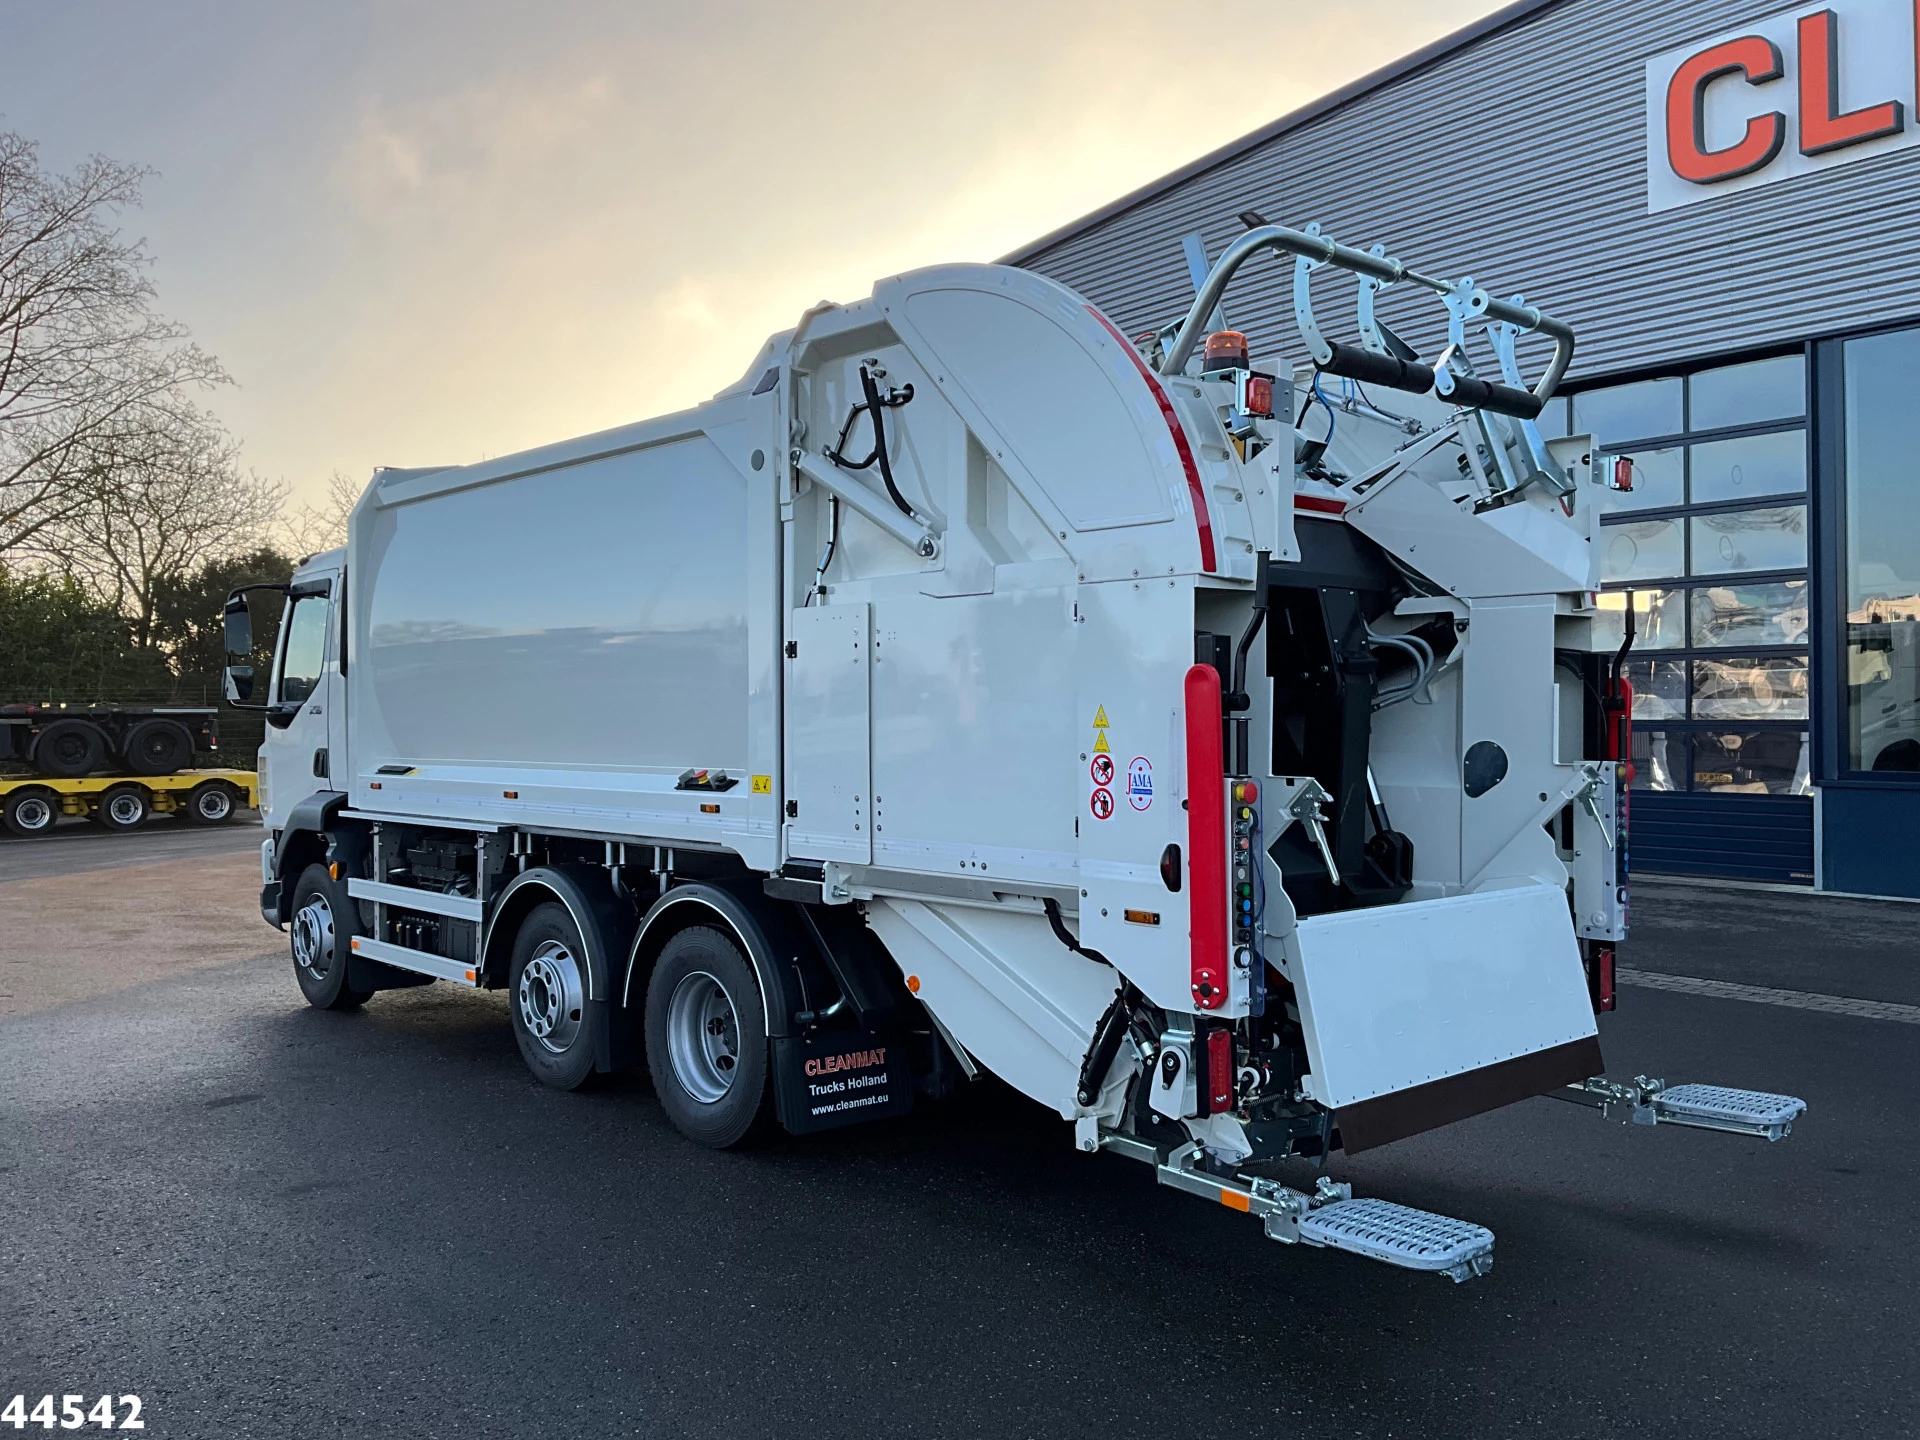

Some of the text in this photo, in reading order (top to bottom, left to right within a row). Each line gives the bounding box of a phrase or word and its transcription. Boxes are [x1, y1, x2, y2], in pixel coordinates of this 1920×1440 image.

[1666, 0, 1920, 185] CL
[1126, 772, 1153, 795] JAMA
[805, 1048, 886, 1076] CLEANMAT
[809, 1073, 888, 1096] Trucks Holland
[811, 1094, 889, 1115] www.cleanmat.eu
